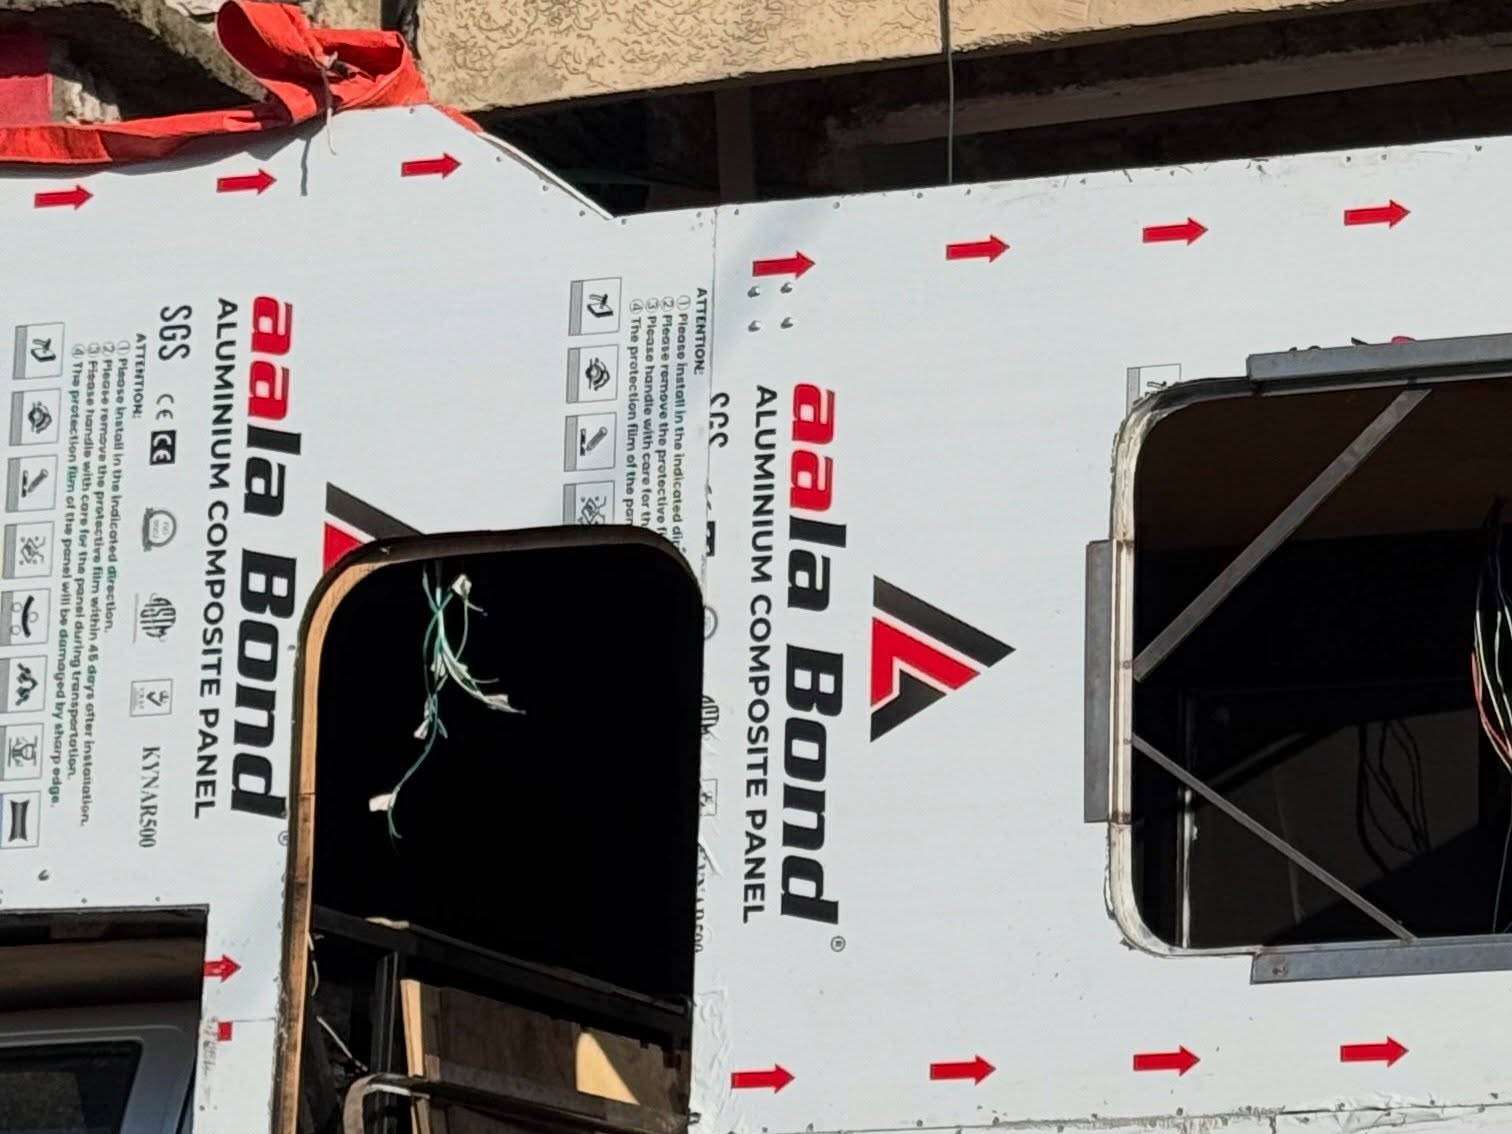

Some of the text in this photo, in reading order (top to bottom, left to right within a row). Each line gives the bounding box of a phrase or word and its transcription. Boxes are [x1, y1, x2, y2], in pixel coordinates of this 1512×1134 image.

[159, 306, 192, 361] SGS
[629, 317, 644, 345] The
[643, 316, 659, 363] Please
[660, 315, 675, 362] Please
[674, 314, 689, 362] Please
[693, 288, 708, 376] ATTENTION:
[132, 333, 147, 418] ATTENTION:
[625, 347, 643, 422] protection
[642, 365, 657, 416] handle
[658, 365, 672, 421] remove
[674, 363, 689, 409] install
[156, 395, 174, 421] CE
[673, 411, 686, 425] in
[626, 424, 641, 453] film
[641, 419, 656, 451] with
[657, 423, 672, 447] the
[672, 427, 687, 452] the
[624, 470, 639, 497] the
[626, 455, 640, 470] of
[640, 453, 653, 487] care
[653, 450, 671, 526] protective
[671, 454, 686, 523] indicated
[104, 358, 130, 633] Please install in the indicated direction.
[639, 489, 655, 510] for
[48, 361, 85, 808] The protection film of the panel will be damaged by sharp edge.
[66, 361, 98, 781] Please handle with care for the panel during transportation.
[195, 299, 238, 819] ALUMINIUM COMPOSITE PANEL
[231, 297, 302, 819] aala Bond
[79, 360, 114, 828] Please remove the protective film within 45 days after installation.
[742, 386, 778, 924] ALUMINIUM COMPOSITE PANEL
[781, 384, 847, 925] aala Bond
[139, 747, 161, 848] KYNAR500
